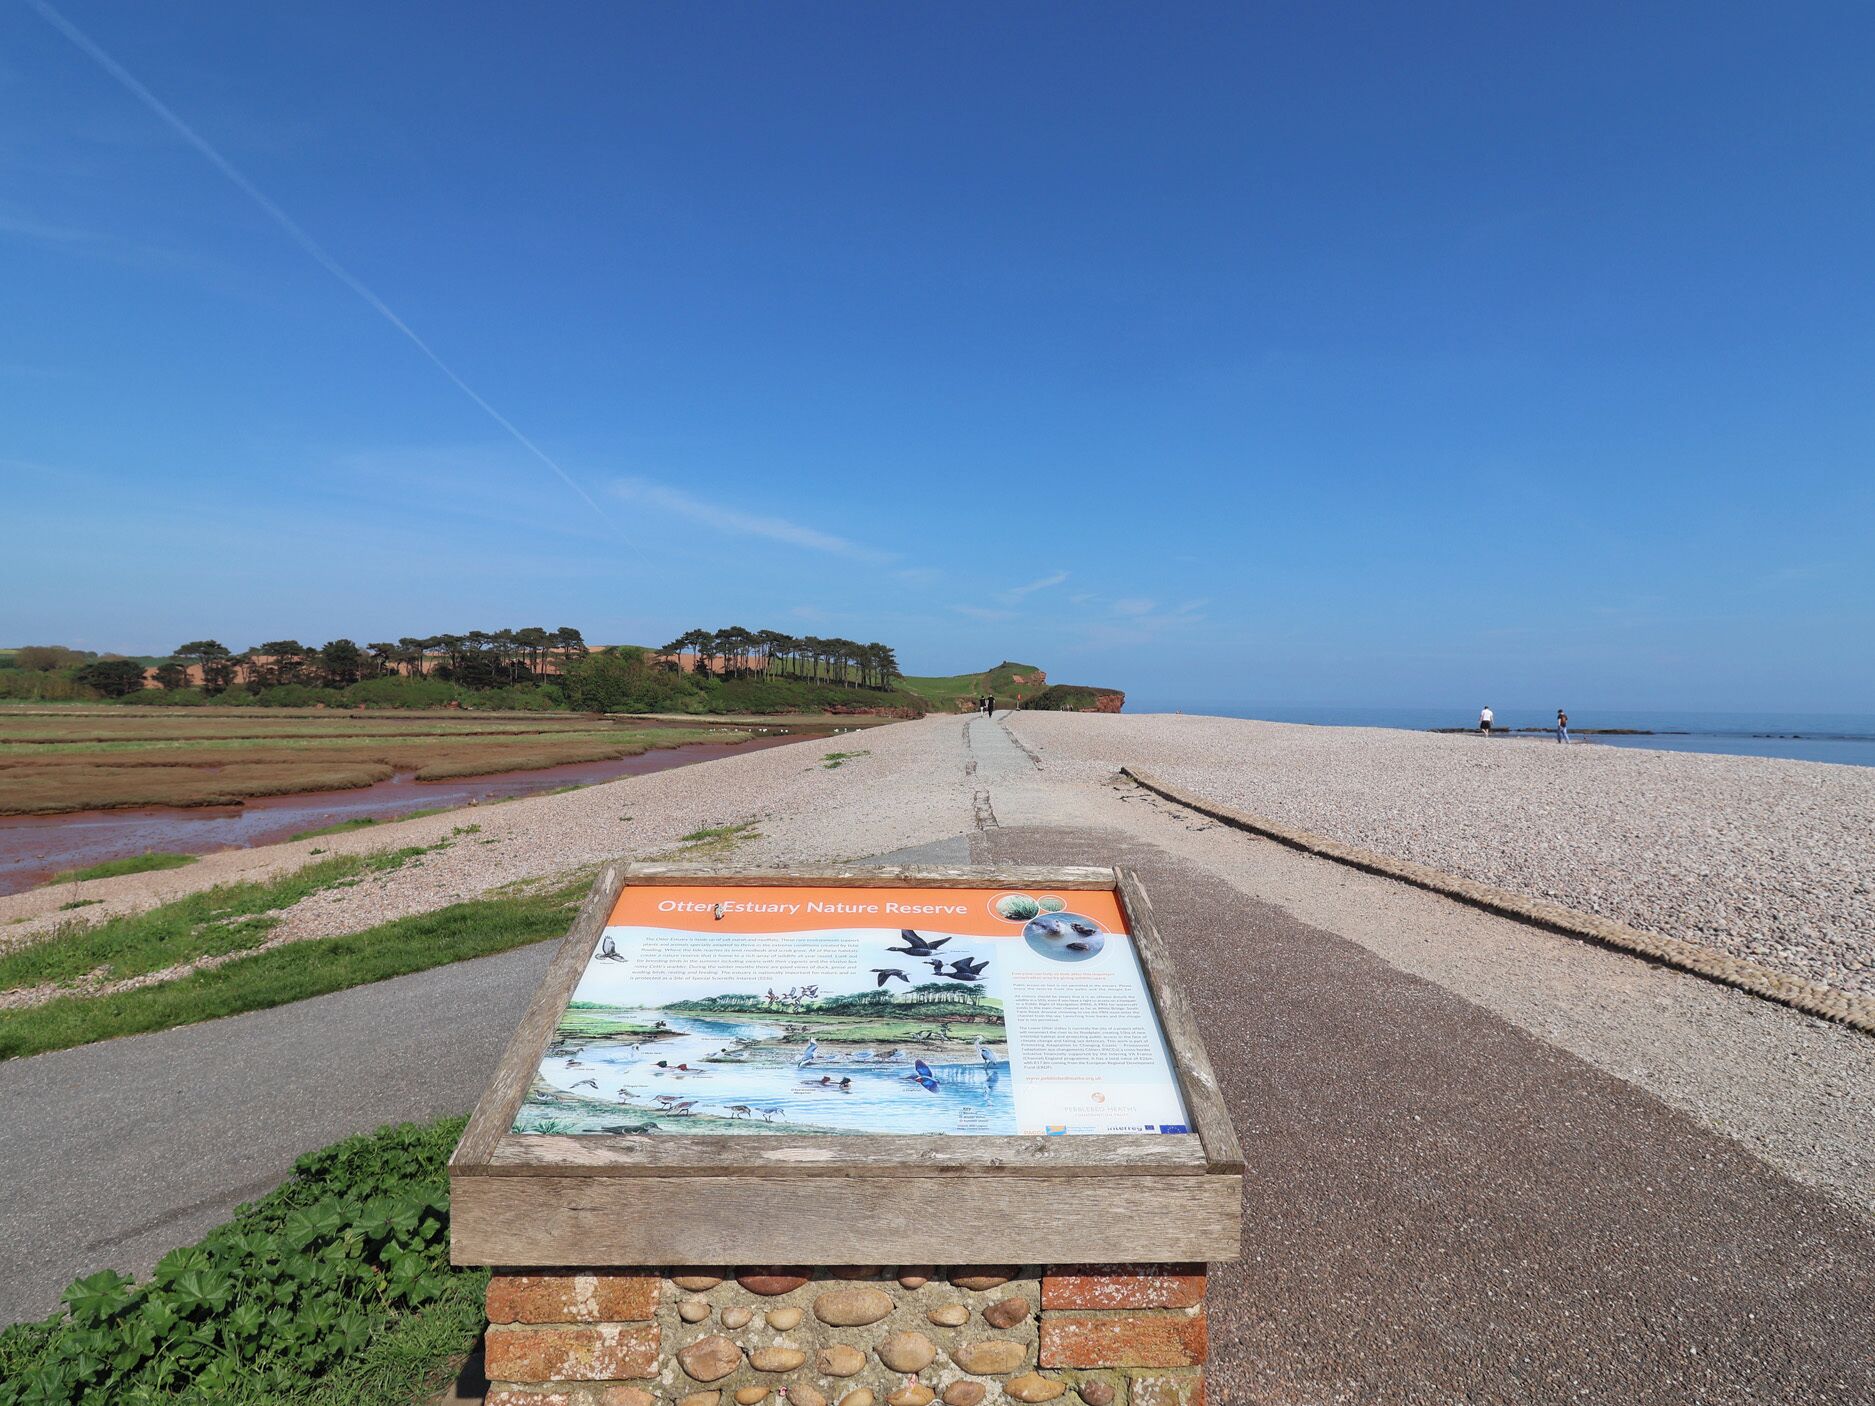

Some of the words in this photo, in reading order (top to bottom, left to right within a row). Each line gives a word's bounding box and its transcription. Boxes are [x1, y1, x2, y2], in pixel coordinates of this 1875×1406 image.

[658, 900, 715, 912] Otter
[722, 900, 800, 914] Estuary
[806, 901, 879, 913] Nature
[885, 902, 967, 914] Reserve
